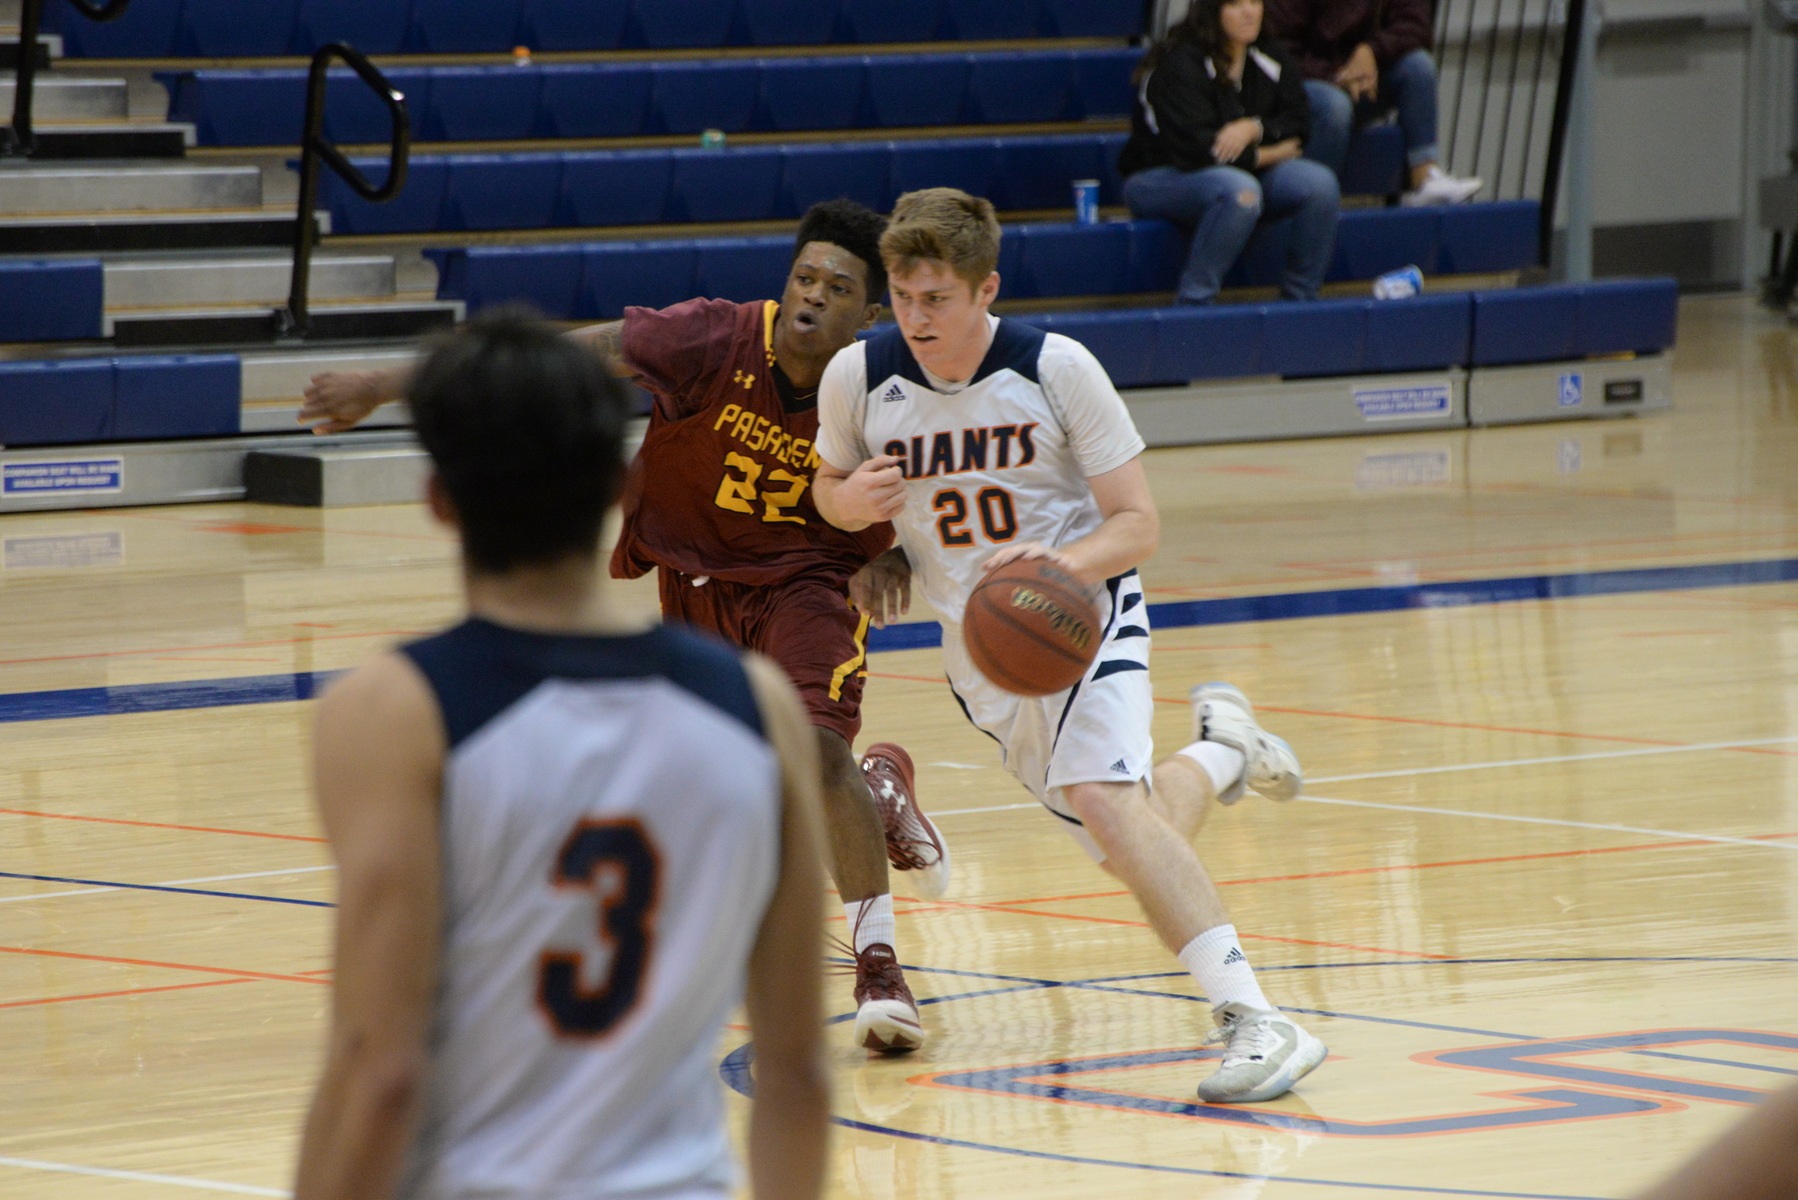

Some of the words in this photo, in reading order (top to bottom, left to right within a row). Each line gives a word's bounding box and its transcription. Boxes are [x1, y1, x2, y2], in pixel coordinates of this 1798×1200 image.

[884, 422, 1040, 480] GIANTS
[714, 451, 810, 525] 22
[931, 485, 1020, 548] 20
[534, 815, 664, 1043] 3
